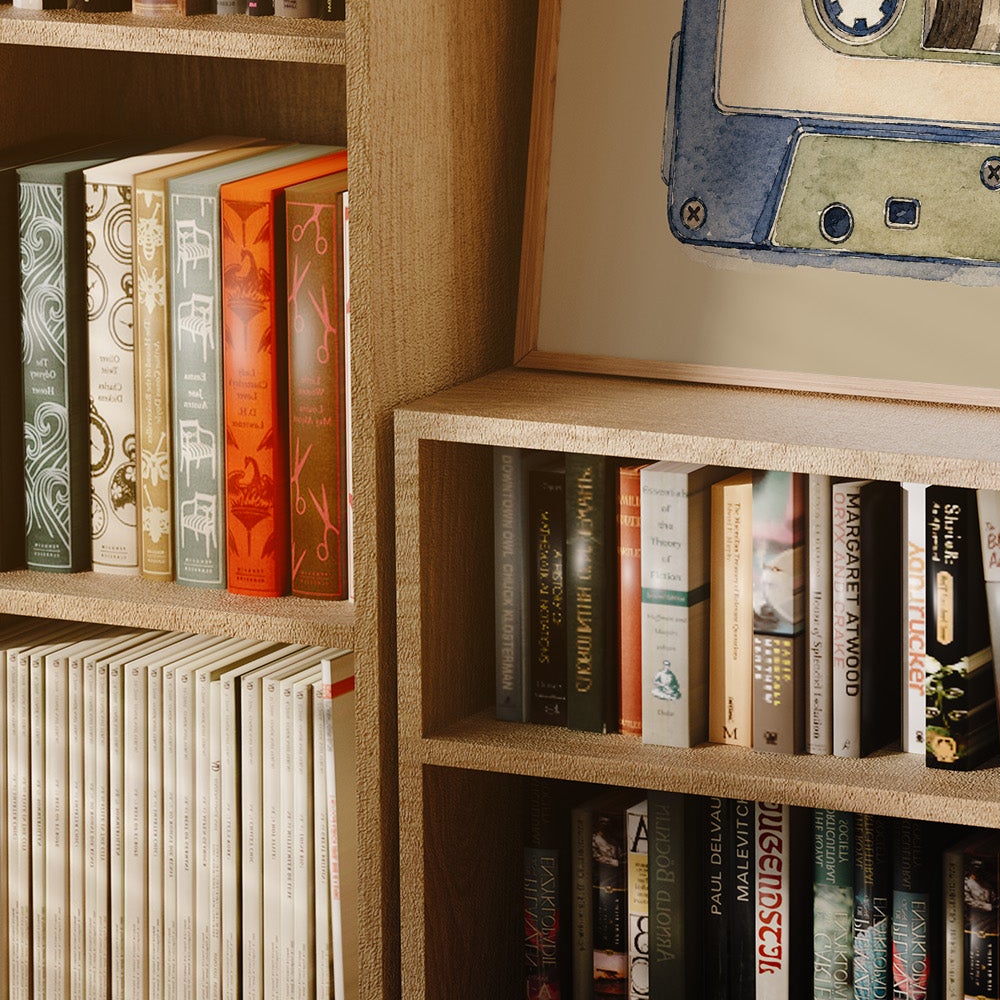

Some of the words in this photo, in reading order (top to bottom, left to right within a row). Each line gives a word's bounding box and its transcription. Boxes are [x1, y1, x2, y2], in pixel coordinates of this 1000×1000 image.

[834, 492, 846, 544] ORYX
[834, 551, 846, 594] AND
[846, 493, 860, 607] MARGARET
[502, 608, 514, 691] KLOSTERMAN
[834, 600, 846, 669] CRAKE
[845, 611, 860, 697] ATWOOD
[722, 725, 738, 741] M
[710, 870, 722, 916] PAUL
